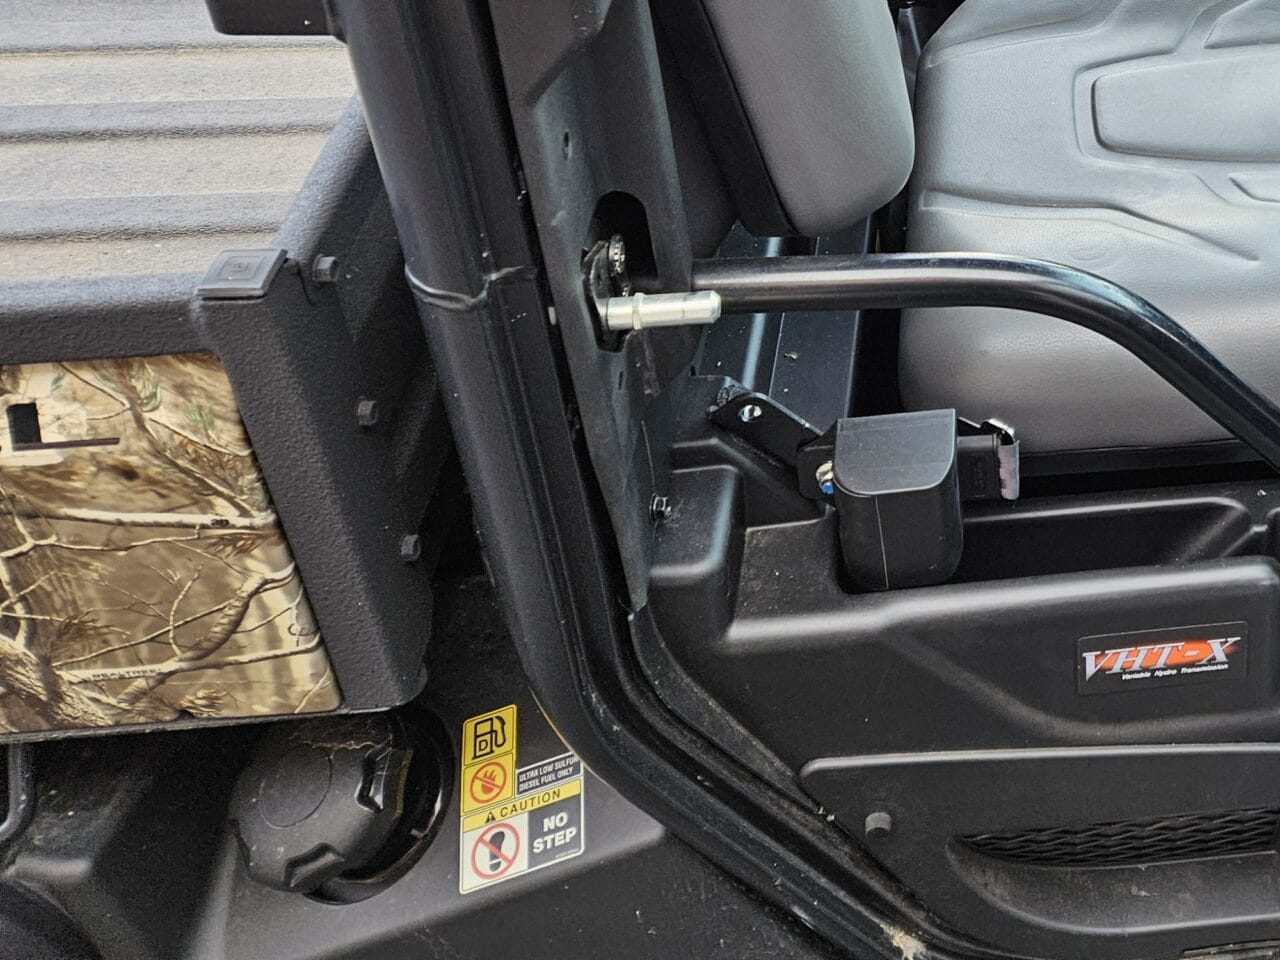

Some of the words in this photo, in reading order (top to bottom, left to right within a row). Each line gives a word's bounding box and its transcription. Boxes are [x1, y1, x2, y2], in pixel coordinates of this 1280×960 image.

[1081, 636, 1242, 681] VHT-X
[1154, 669, 1177, 677] Hydro
[518, 769, 539, 782] ULTRA
[539, 764, 554, 775] LOW
[519, 779, 540, 792] DIESEL
[540, 774, 556, 785] FUEL
[557, 766, 574, 779] ONLY
[499, 788, 561, 818] CAUTION
[543, 811, 568, 833] NO
[532, 826, 577, 854] STEP
